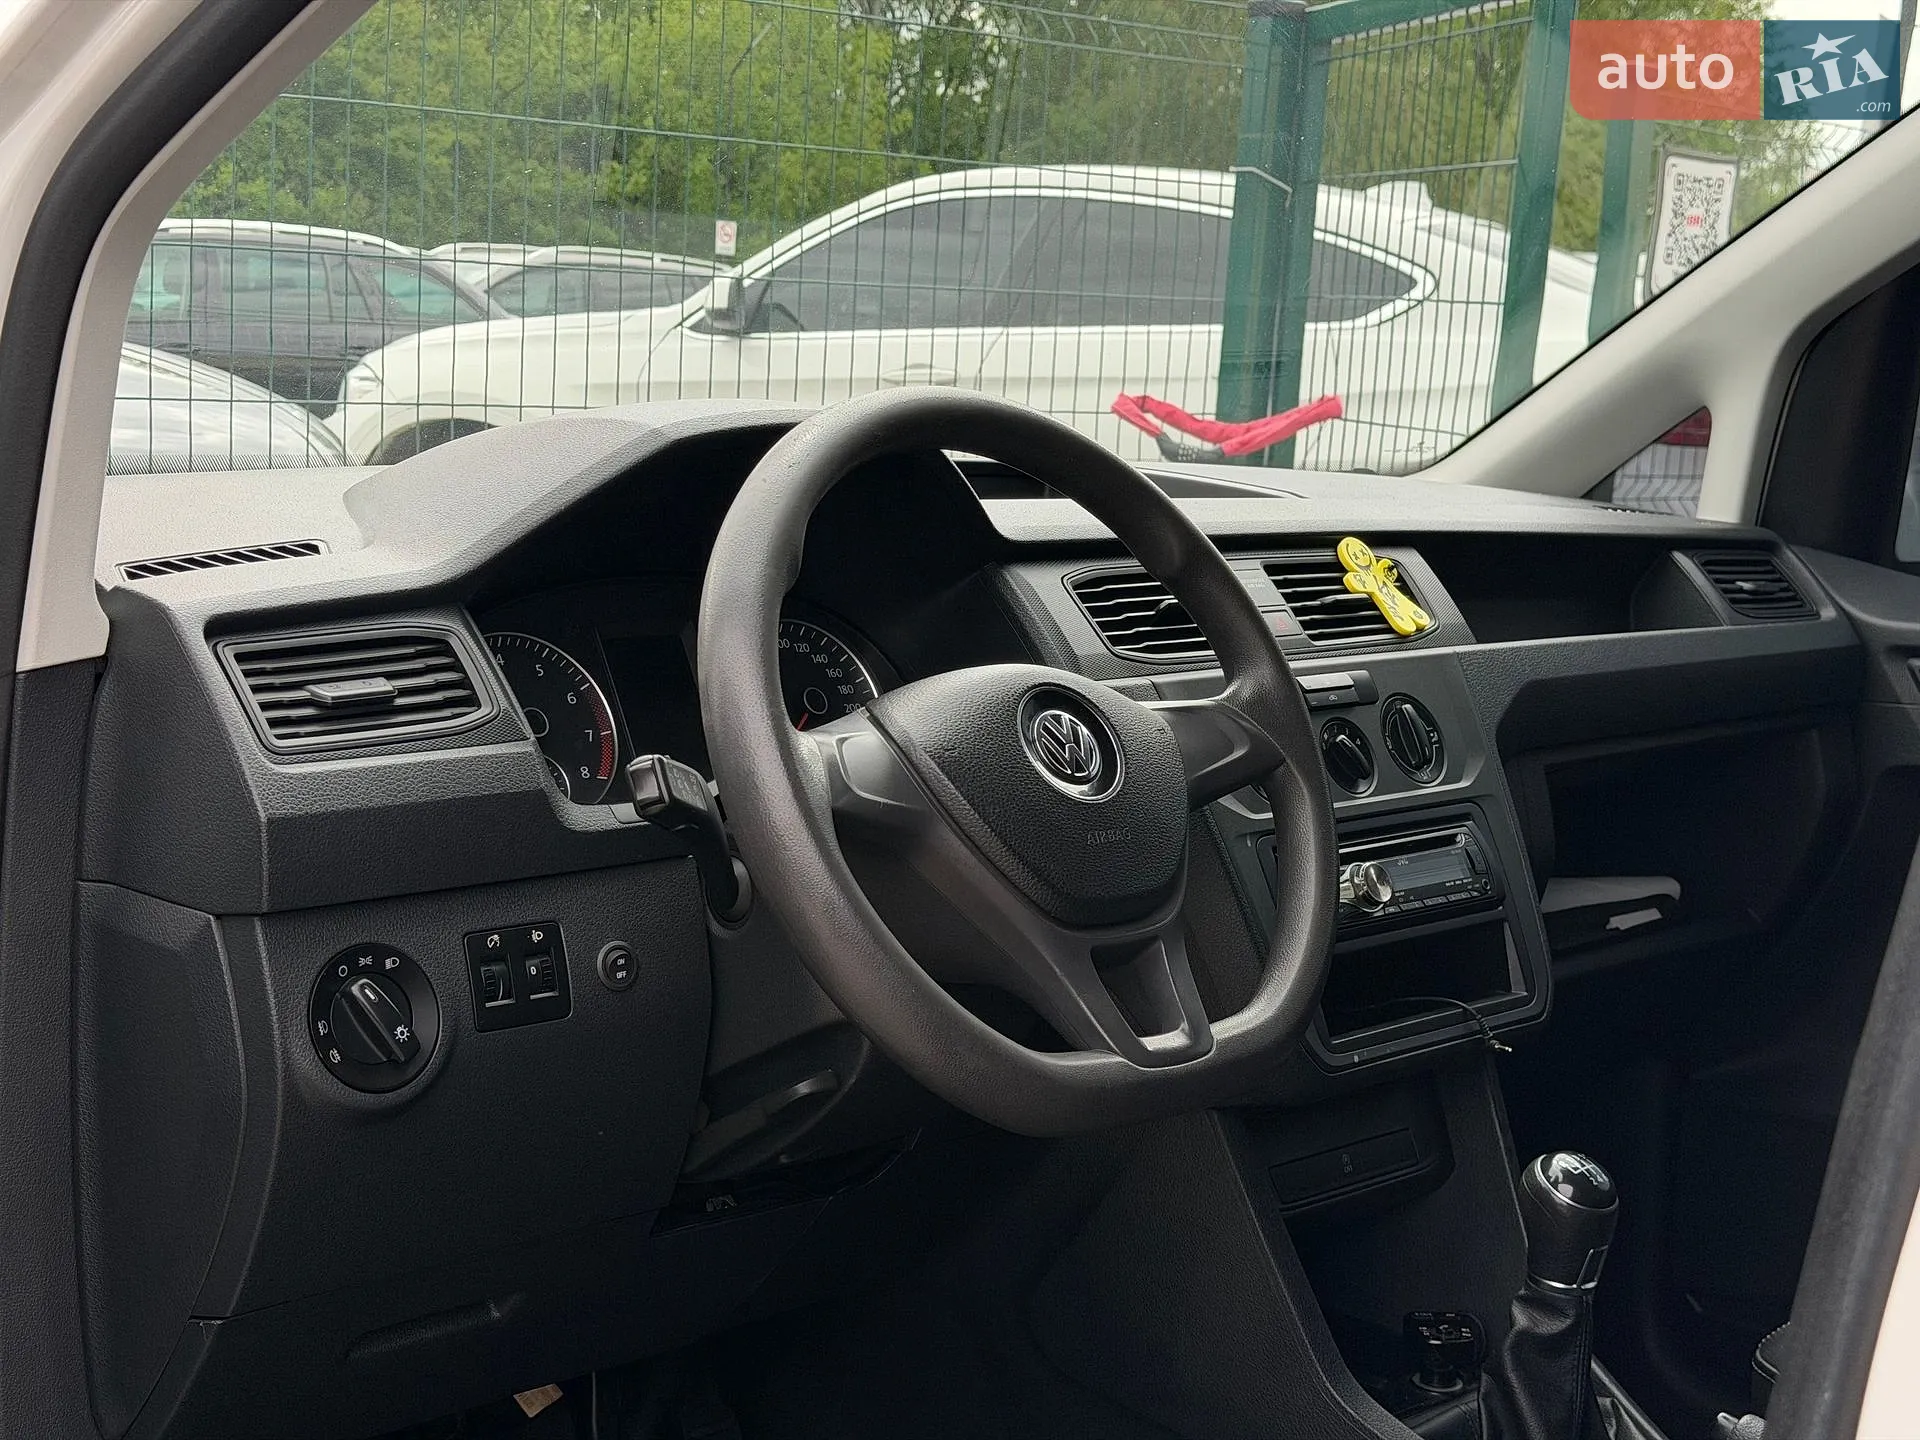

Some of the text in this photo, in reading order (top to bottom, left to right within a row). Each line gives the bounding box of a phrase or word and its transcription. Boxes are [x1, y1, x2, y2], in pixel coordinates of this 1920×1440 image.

[777, 638, 790, 649] 00
[793, 643, 810, 653] 120
[811, 654, 829, 664] 140
[535, 664, 544, 677] 5
[825, 668, 843, 678] 160
[837, 684, 855, 695] 180
[567, 692, 577, 705] 6
[584, 729, 593, 742] 7
[580, 766, 590, 779] 8
[617, 958, 625, 966] ON
[616, 970, 628, 979] OFF
